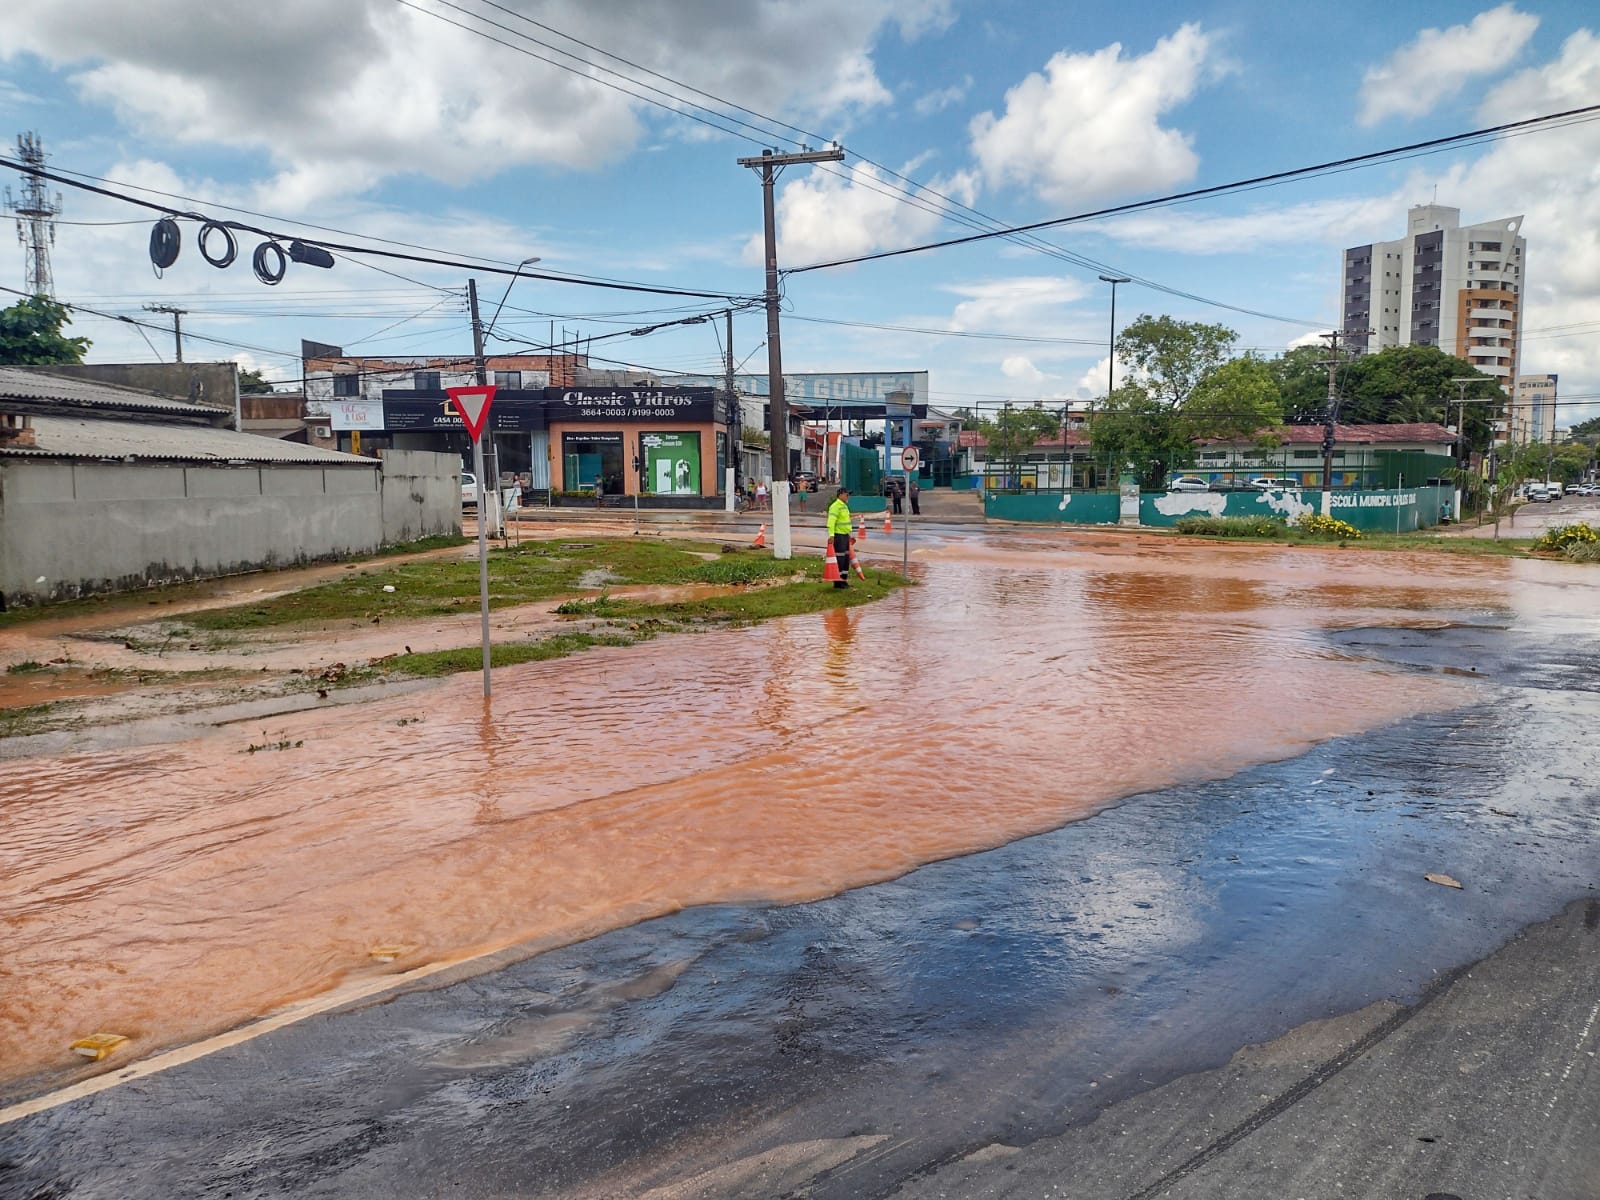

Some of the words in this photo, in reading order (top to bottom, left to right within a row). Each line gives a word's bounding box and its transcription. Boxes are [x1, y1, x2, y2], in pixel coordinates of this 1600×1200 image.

[563, 391, 626, 406] Classic
[631, 391, 692, 406] Vidros
[433, 416, 451, 424] CASA
[453, 416, 465, 424] DO
